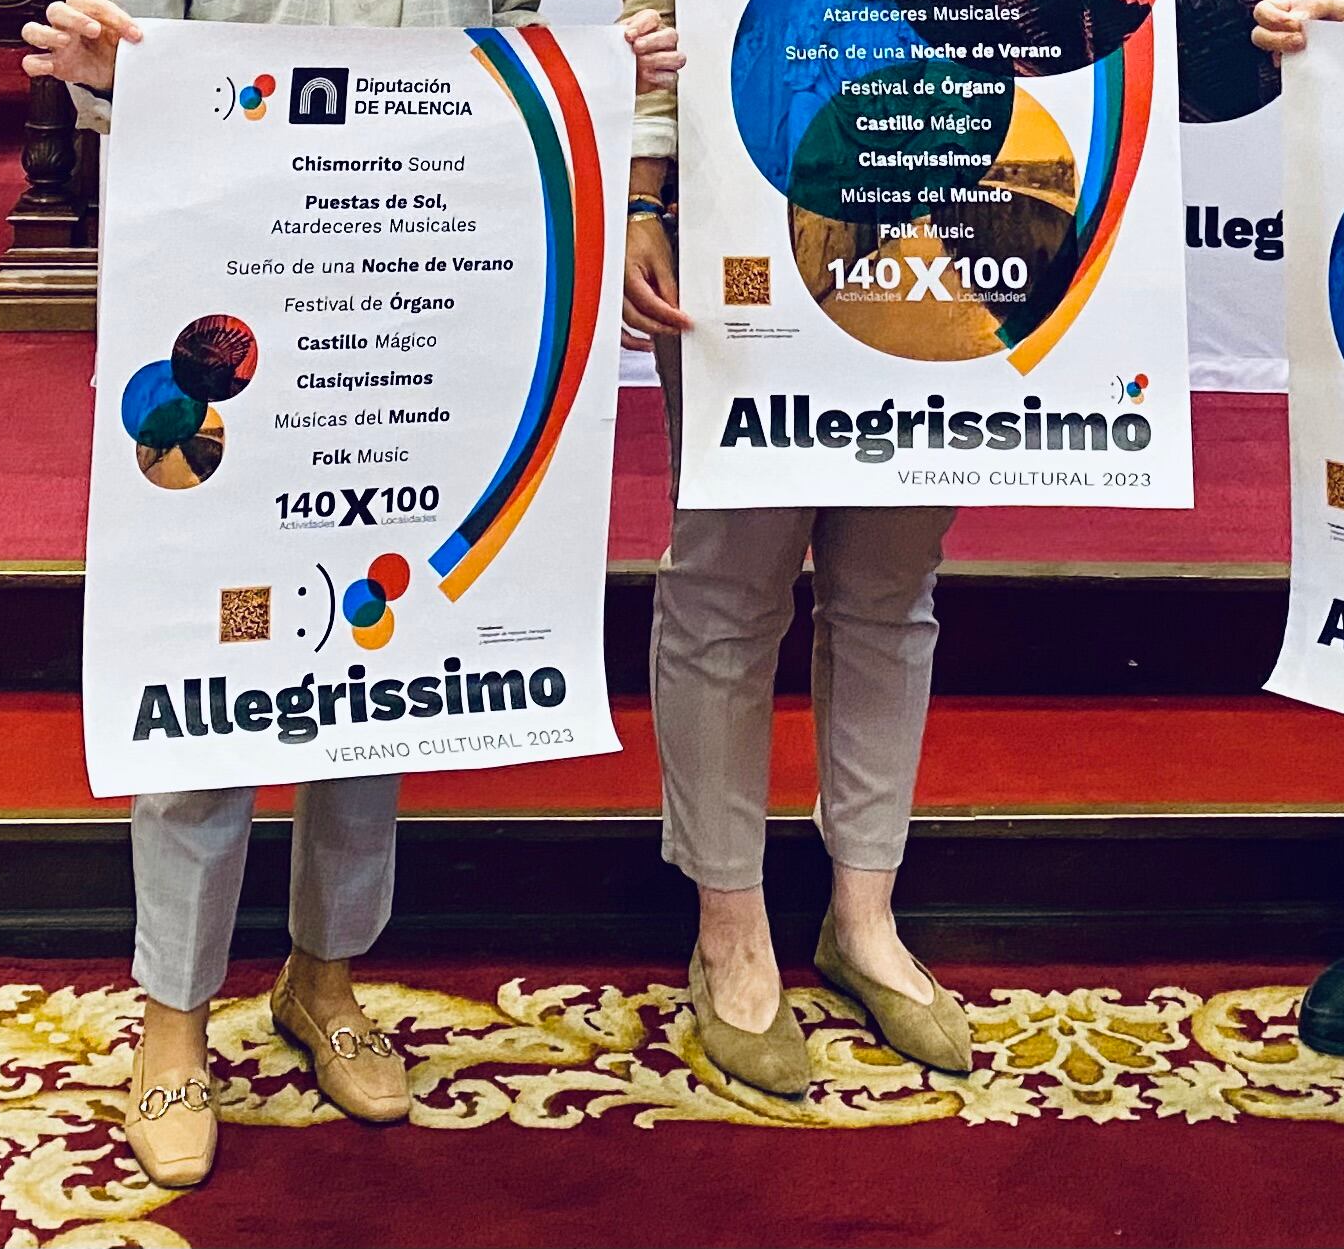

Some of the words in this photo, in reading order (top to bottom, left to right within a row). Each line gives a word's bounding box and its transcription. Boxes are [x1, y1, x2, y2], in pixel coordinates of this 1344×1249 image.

[824, 7, 927, 22] Atardeceres
[932, 6, 1020, 21] Musicales
[785, 45, 839, 61] Sueño
[845, 45, 867, 60] de
[873, 47, 905, 59] una
[911, 44, 967, 58] Noche
[971, 44, 995, 58] de
[999, 44, 1062, 58] Verano
[356, 78, 450, 95] Diputación
[841, 80, 909, 95] Festival
[913, 80, 935, 95] de
[941, 75, 1006, 98] Órgano
[355, 101, 379, 114] DE
[385, 101, 472, 115] PALENCIA
[856, 117, 924, 131] Castillo
[930, 115, 992, 134] Mágico
[293, 156, 402, 171] Chismorrito
[409, 156, 464, 171] Sound
[306, 195, 380, 209] Puestas
[386, 194, 407, 209] de
[413, 194, 446, 211] Sol,
[841, 185, 911, 203] Músicas
[917, 187, 946, 202] del
[950, 188, 1012, 202] Mundo
[271, 218, 381, 234] Atardeceres
[390, 217, 476, 232] Musicales
[880, 223, 918, 239] Folk
[923, 223, 974, 239] Music
[227, 259, 284, 275] Sueño
[293, 259, 314, 274] de
[322, 261, 355, 274] una
[362, 258, 419, 272] Noche
[425, 257, 446, 271] de
[453, 258, 513, 271] Verano
[285, 296, 354, 312] Festival
[361, 296, 382, 310] de
[390, 292, 454, 313] Órgano
[835, 290, 902, 302] Actividades
[957, 290, 1027, 302] Localidades
[298, 334, 367, 350] Castillo
[376, 332, 436, 352] Mágico
[275, 412, 347, 428] Músicas
[355, 409, 382, 425] del
[389, 407, 450, 424] Mundo
[720, 394, 1152, 463] Allegrissimo
[313, 449, 351, 465] Folk
[358, 447, 408, 463] Music
[898, 471, 980, 485] VERANO
[990, 472, 1093, 485] CULTURAL
[1103, 473, 1150, 486] 2023
[132, 657, 567, 745] Allegrissimo
[326, 743, 409, 762] VERANO
[419, 734, 521, 755] CULTURAL
[527, 729, 573, 745] 2023
